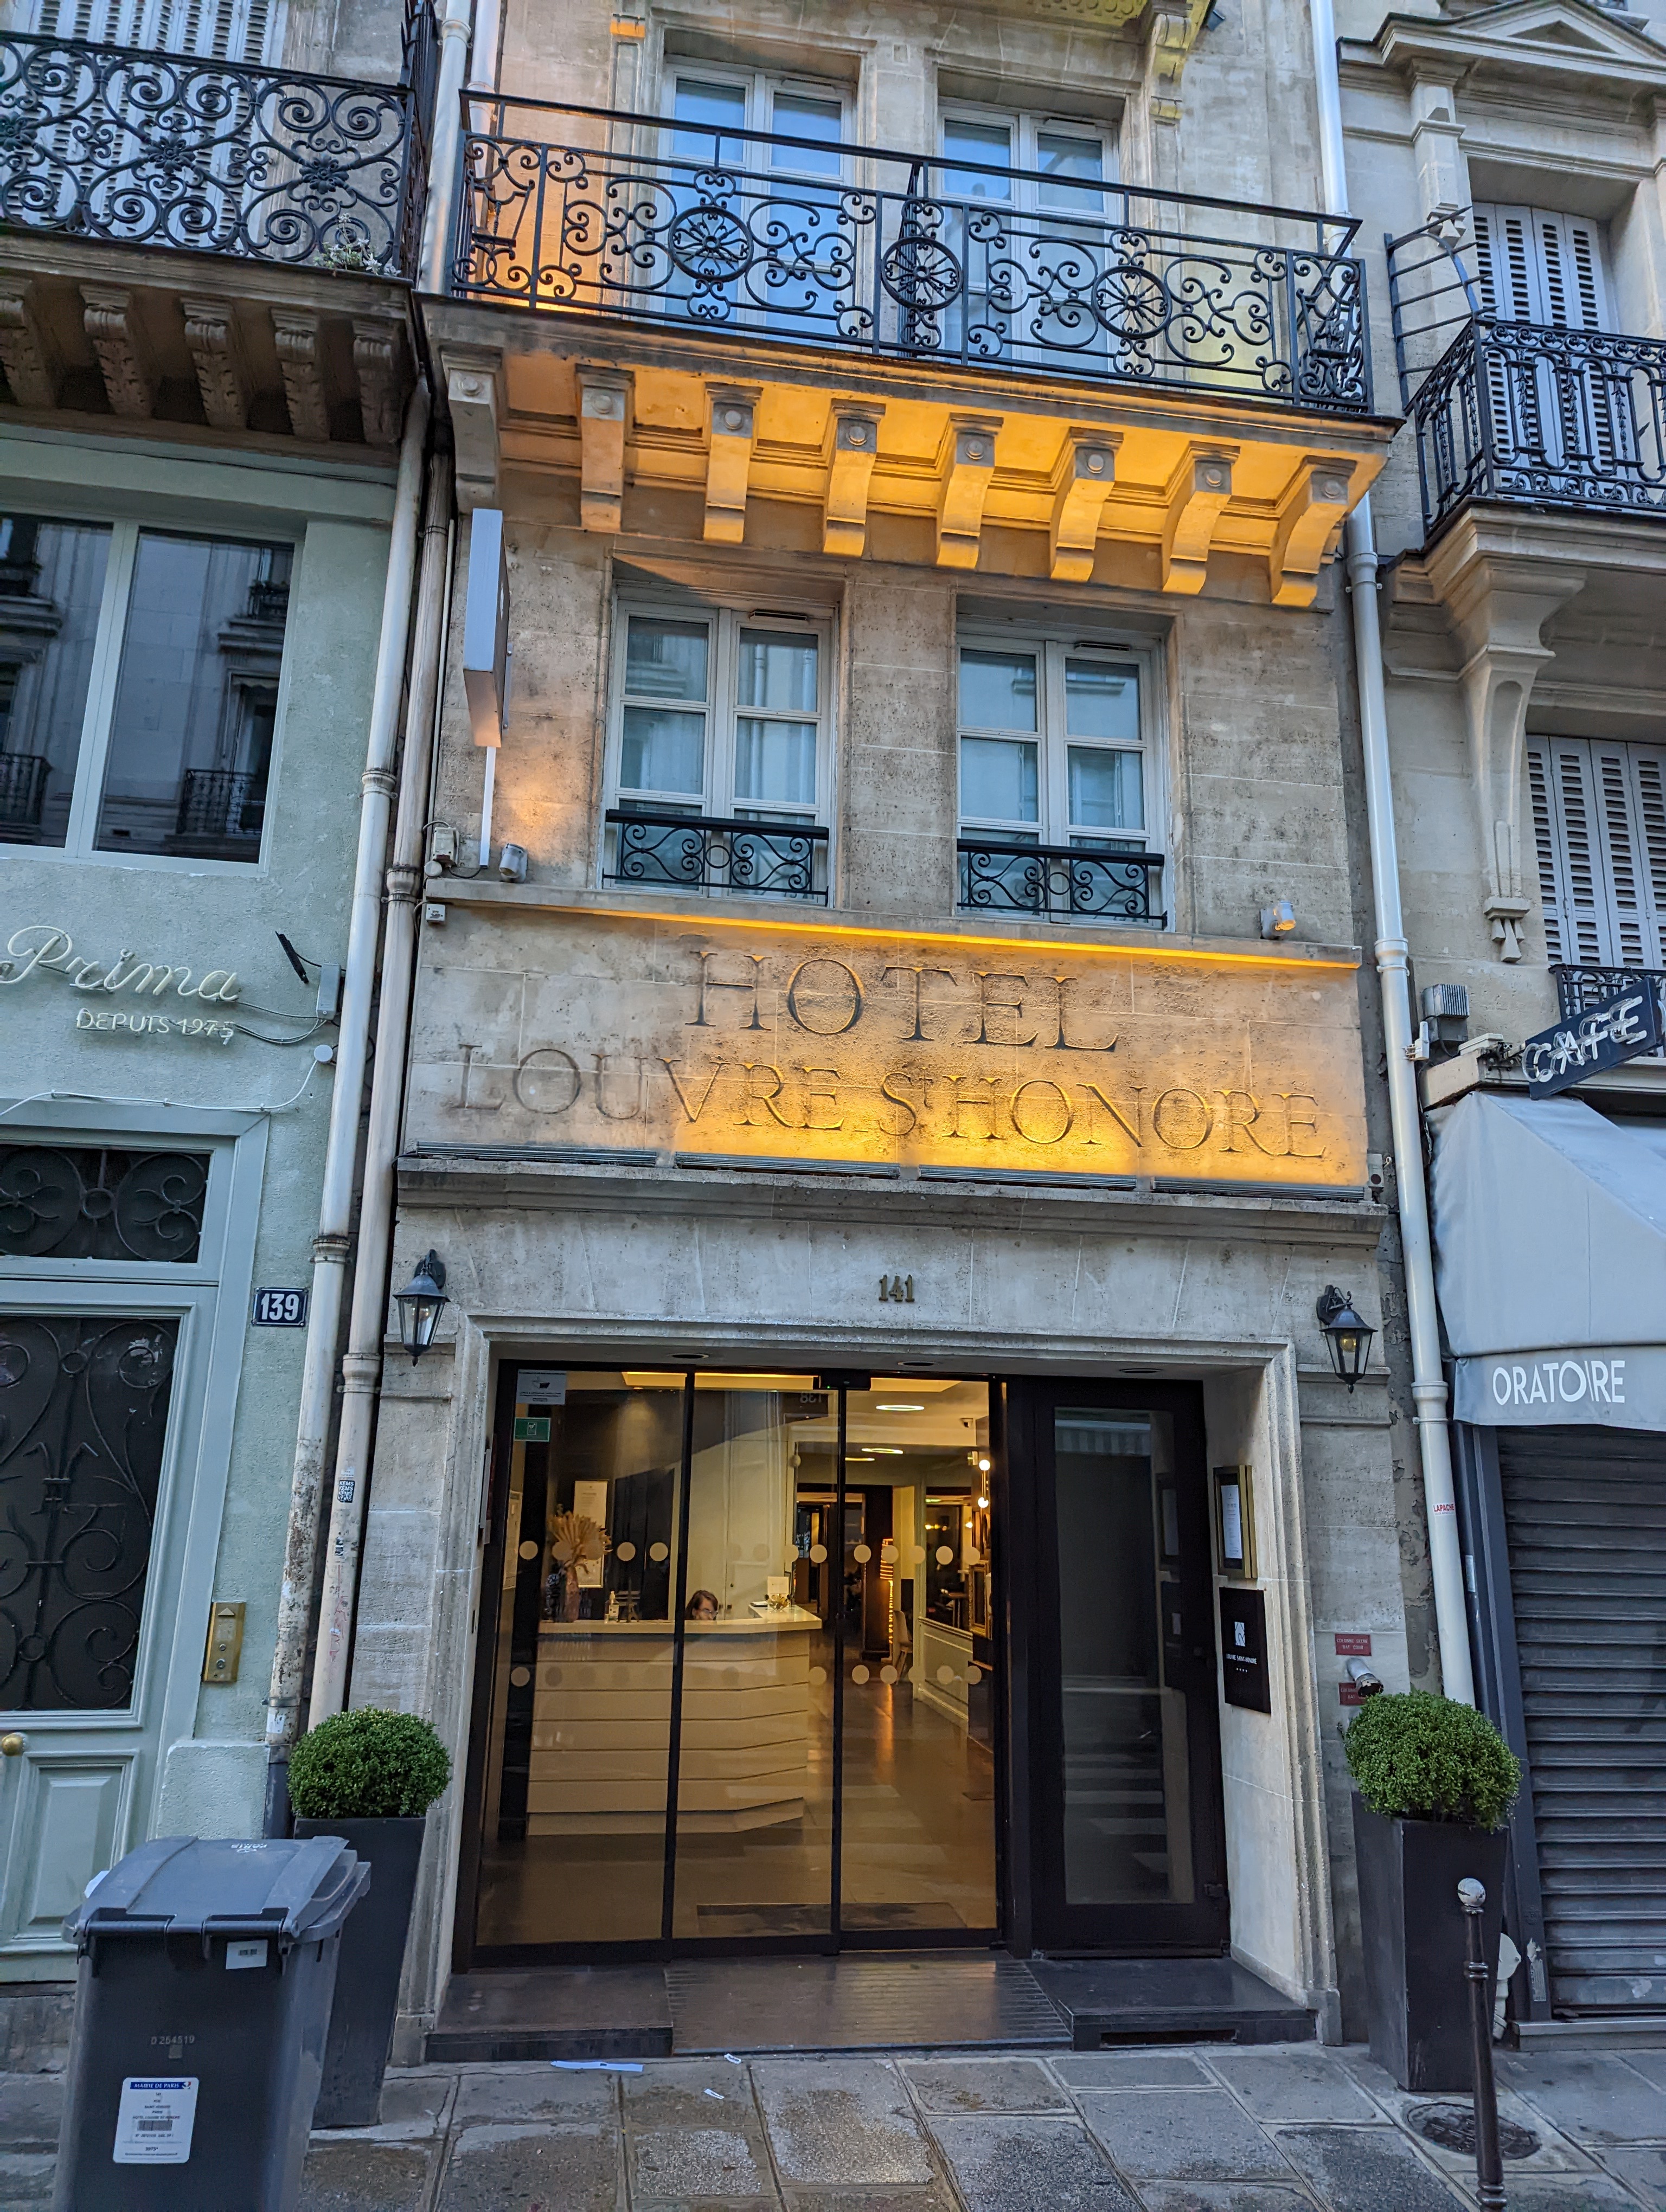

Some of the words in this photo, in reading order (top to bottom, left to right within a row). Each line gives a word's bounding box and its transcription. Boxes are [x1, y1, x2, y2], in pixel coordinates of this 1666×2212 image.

[0, 925, 239, 1002] Prima
[76, 1008, 170, 1034] DEPUIS
[684, 950, 1118, 1052] HOTEL
[453, 1043, 845, 1132] LOUVRE
[942, 1075, 1327, 1158] HONORE
[261, 1293, 299, 1321] 139
[879, 1274, 915, 1302] 141
[1492, 1360, 1625, 1405] ORATOIRE
